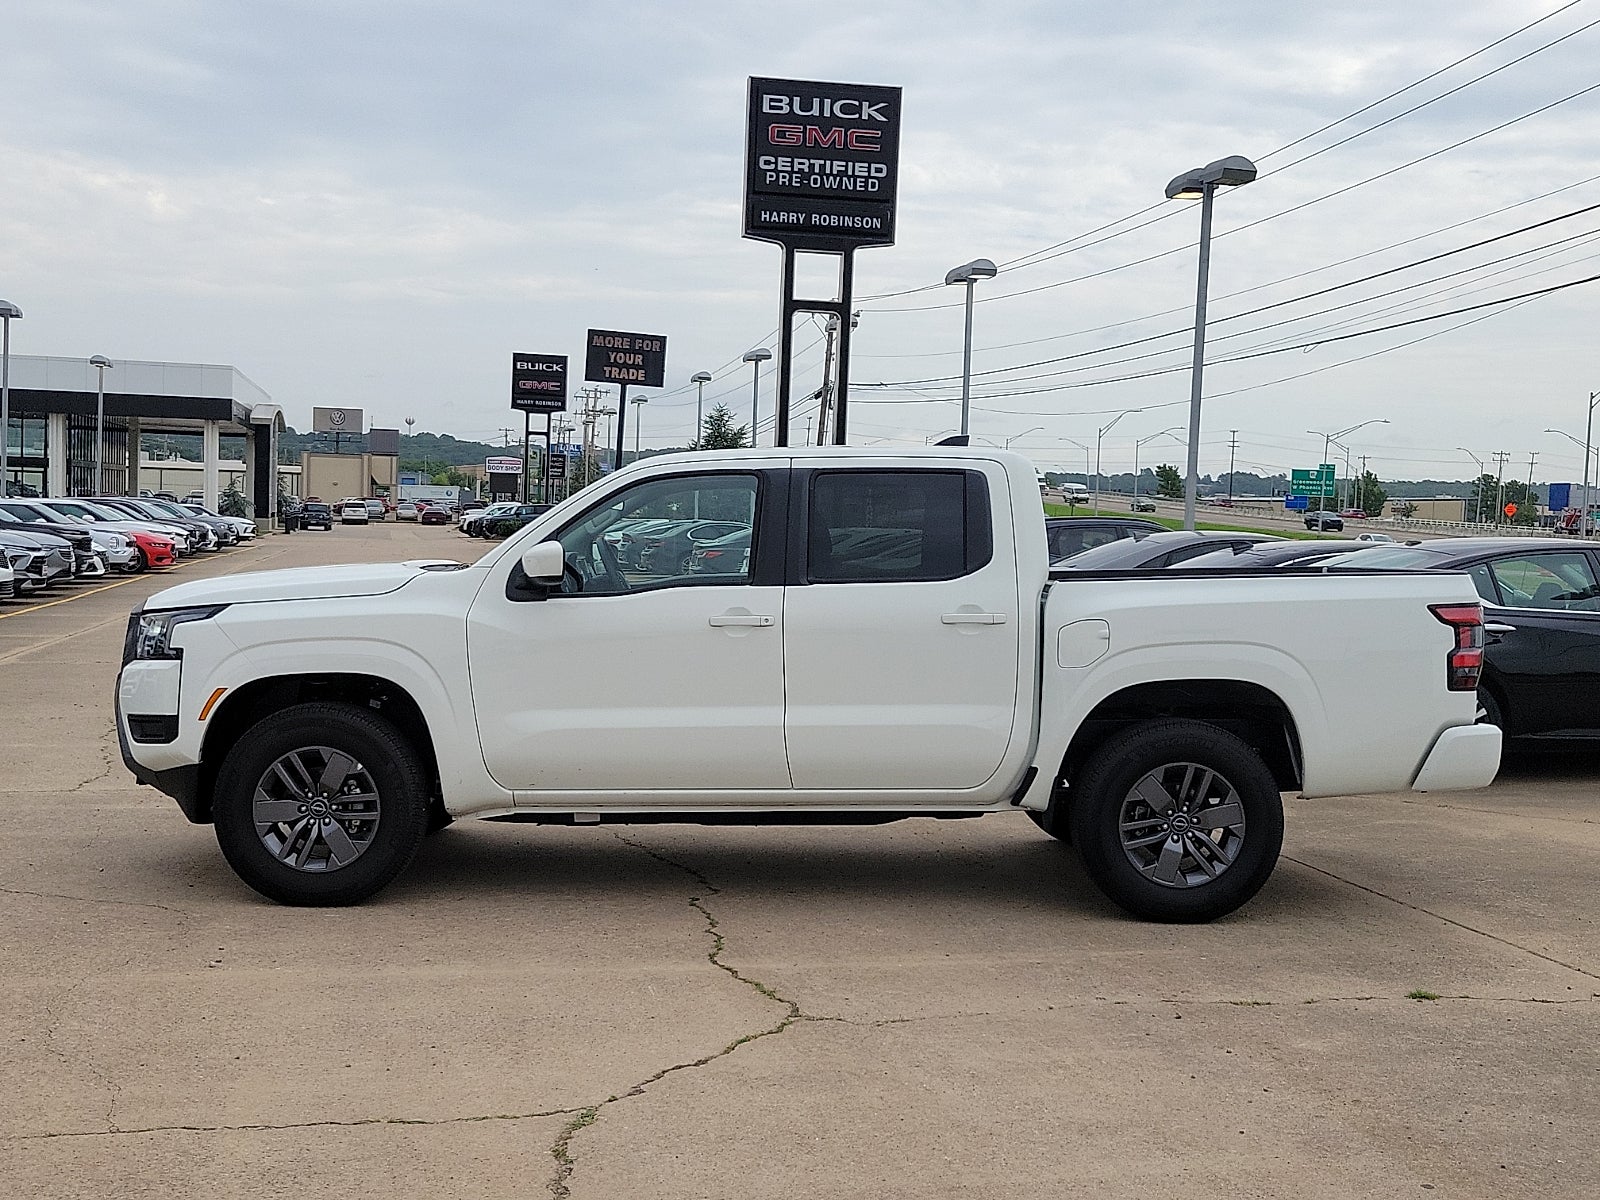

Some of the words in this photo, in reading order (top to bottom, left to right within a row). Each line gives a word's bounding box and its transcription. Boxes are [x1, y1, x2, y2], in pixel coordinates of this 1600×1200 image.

[762, 94, 889, 122] BUICK
[768, 123, 881, 151] GMC
[758, 155, 888, 178] CERTIFIED
[766, 172, 880, 192] PRE-OWNED
[760, 210, 806, 225] HARRY
[811, 214, 882, 229] ROBINSON
[591, 335, 631, 349] MORE
[635, 339, 662, 352] FOR
[516, 361, 564, 372] BUICK
[608, 351, 643, 365] YOUR
[603, 366, 646, 381] TRADE
[518, 380, 561, 391] GMC
